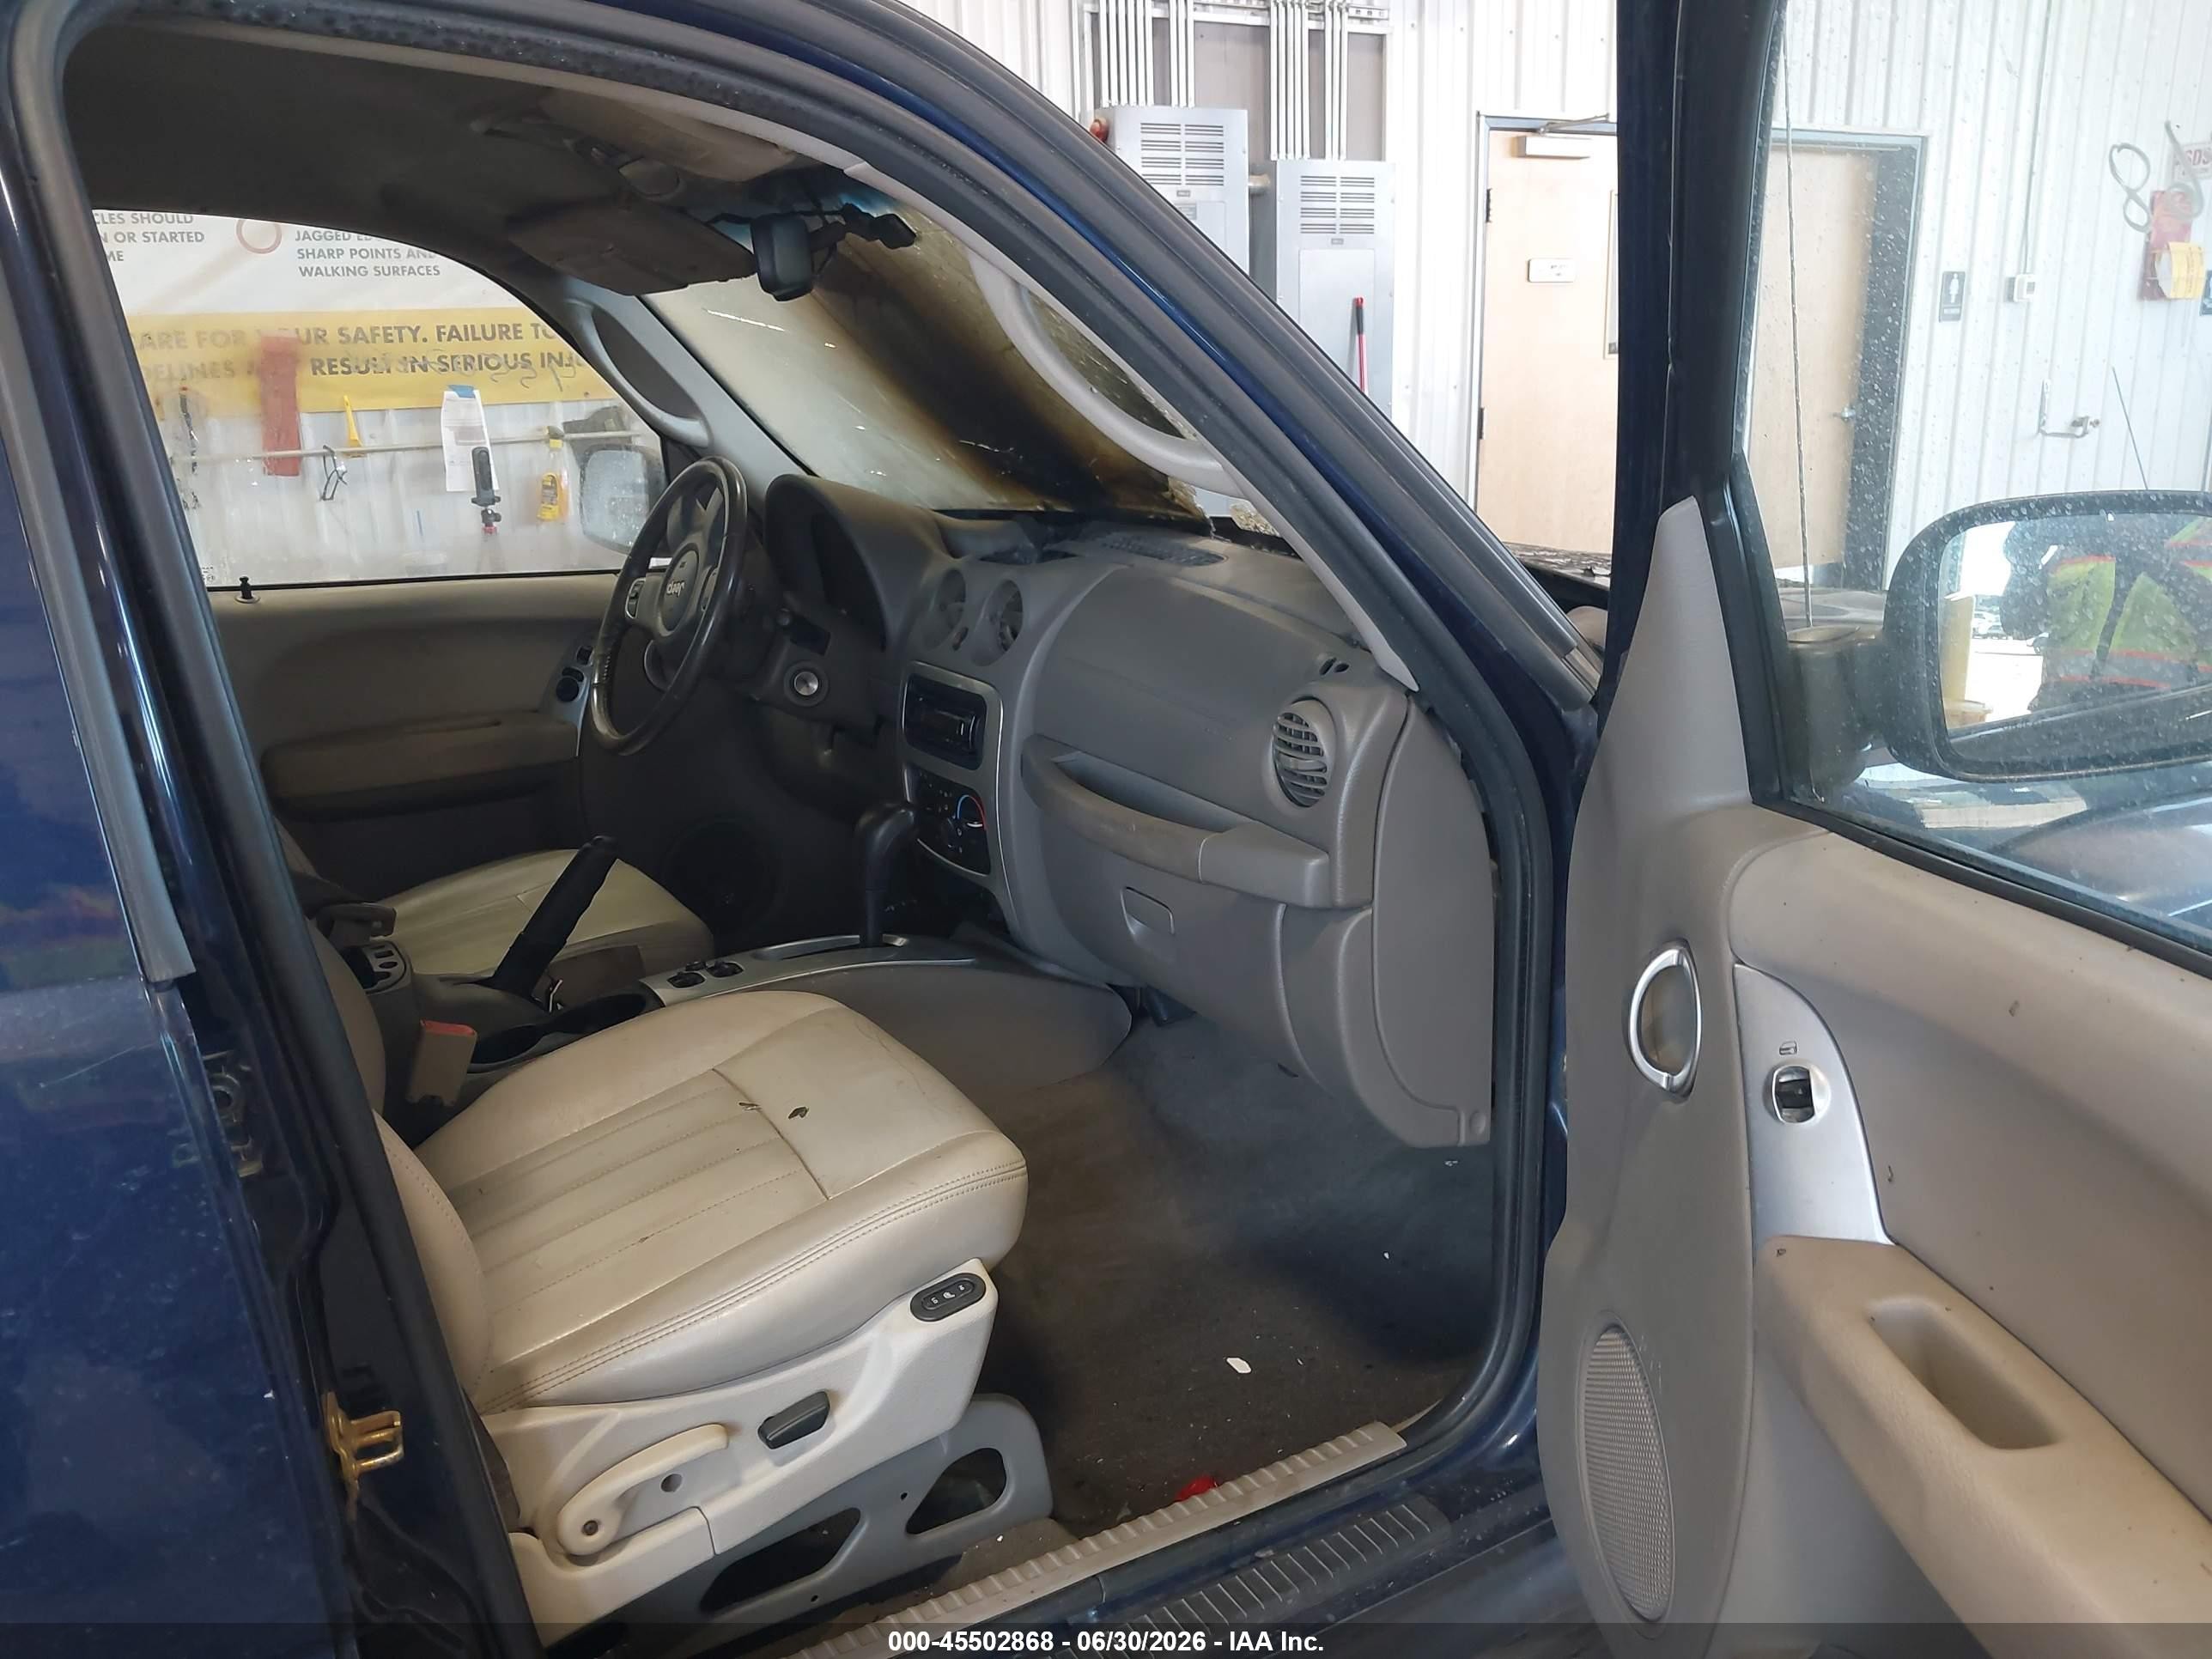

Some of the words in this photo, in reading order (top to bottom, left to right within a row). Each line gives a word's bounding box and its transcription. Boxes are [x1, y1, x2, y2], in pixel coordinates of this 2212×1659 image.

[131, 213, 193, 224] SHOULD
[113, 231, 137, 244] OR
[142, 231, 205, 243] STARTED
[295, 230, 351, 241] JAGGED
[297, 247, 344, 259] SHARP
[349, 247, 401, 259] POINTS
[299, 265, 369, 277] WALKING
[374, 264, 441, 276] SURFACES
[337, 325, 428, 344] SAFETY.
[436, 323, 523, 343] FAILURE
[437, 352, 532, 373] SERIOUS
